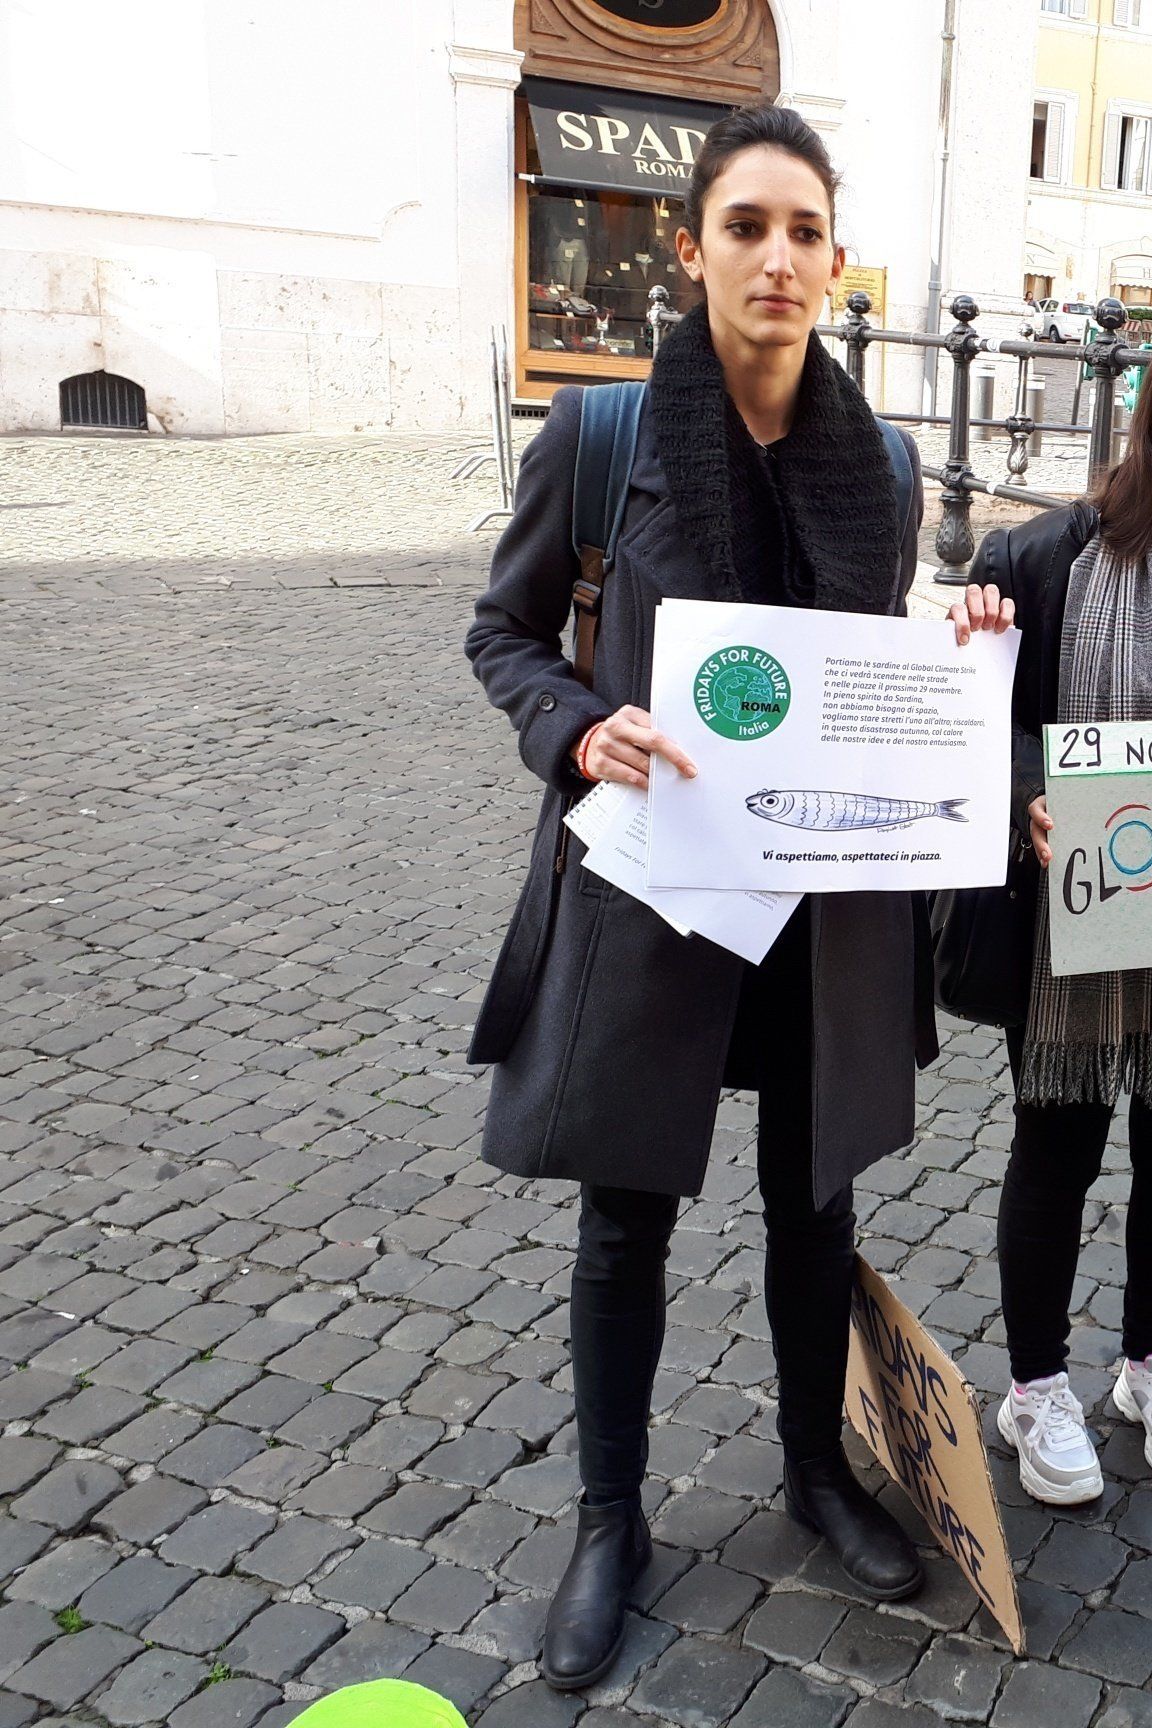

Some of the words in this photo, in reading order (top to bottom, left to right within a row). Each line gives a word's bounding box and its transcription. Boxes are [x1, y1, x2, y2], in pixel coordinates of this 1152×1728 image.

[633, 159, 694, 179] ROM
[826, 658, 862, 667] Portiamo
[864, 660, 870, 668] le
[873, 661, 900, 669] sardine
[911, 664, 933, 672] Global
[935, 665, 959, 673] Climate
[873, 672, 906, 681] scendere
[908, 674, 925, 682] nelle
[697, 660, 720, 721] FRIDAYS
[719, 649, 749, 665] FOR
[752, 652, 788, 700] FUTURE
[831, 680, 850, 688] nelle
[852, 682, 876, 690] piazze
[885, 684, 917, 692] prossimo
[833, 692, 855, 700] pieno
[857, 693, 881, 701] spirito
[895, 695, 924, 704] Sardina,
[741, 701, 781, 713] ROMA
[841, 703, 873, 711] abbiamo
[876, 704, 905, 714] bisogno
[916, 707, 939, 715] spazio,
[823, 713, 858, 721] vogliamo
[881, 716, 903, 724] stretti
[739, 721, 770, 736] Italia
[832, 725, 857, 734] questo
[860, 725, 898, 734] disastroso
[821, 734, 840, 742] delle
[868, 736, 884, 744] idee
[1058, 727, 1102, 768] 29
[762, 850, 775, 861] Vi
[775, 851, 840, 863] aspettiamo,
[841, 851, 900, 863] aspettateci
[900, 851, 910, 861] in
[910, 851, 942, 863] piazza.
[879, 1371, 949, 1497] FOR
[858, 1386, 996, 1609] FUTURE
